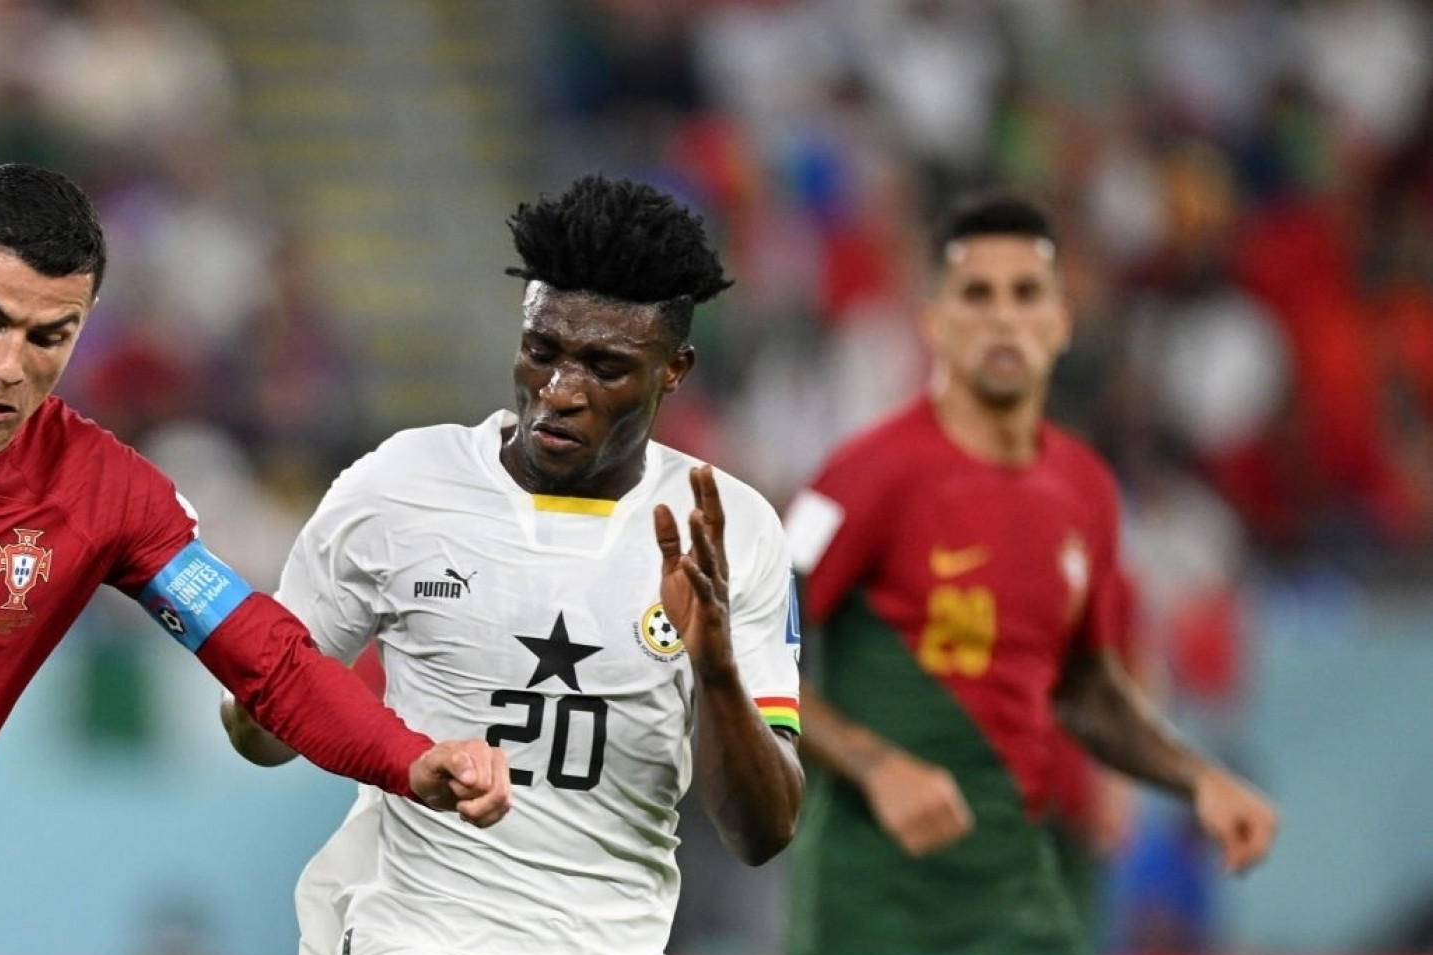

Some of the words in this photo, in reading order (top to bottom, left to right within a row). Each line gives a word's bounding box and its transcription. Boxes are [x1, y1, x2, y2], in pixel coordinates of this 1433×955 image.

[166, 558, 206, 596] FOOTBALL
[175, 565, 218, 605] UNITES
[413, 581, 461, 599] PUMA
[486, 689, 608, 791] 20
